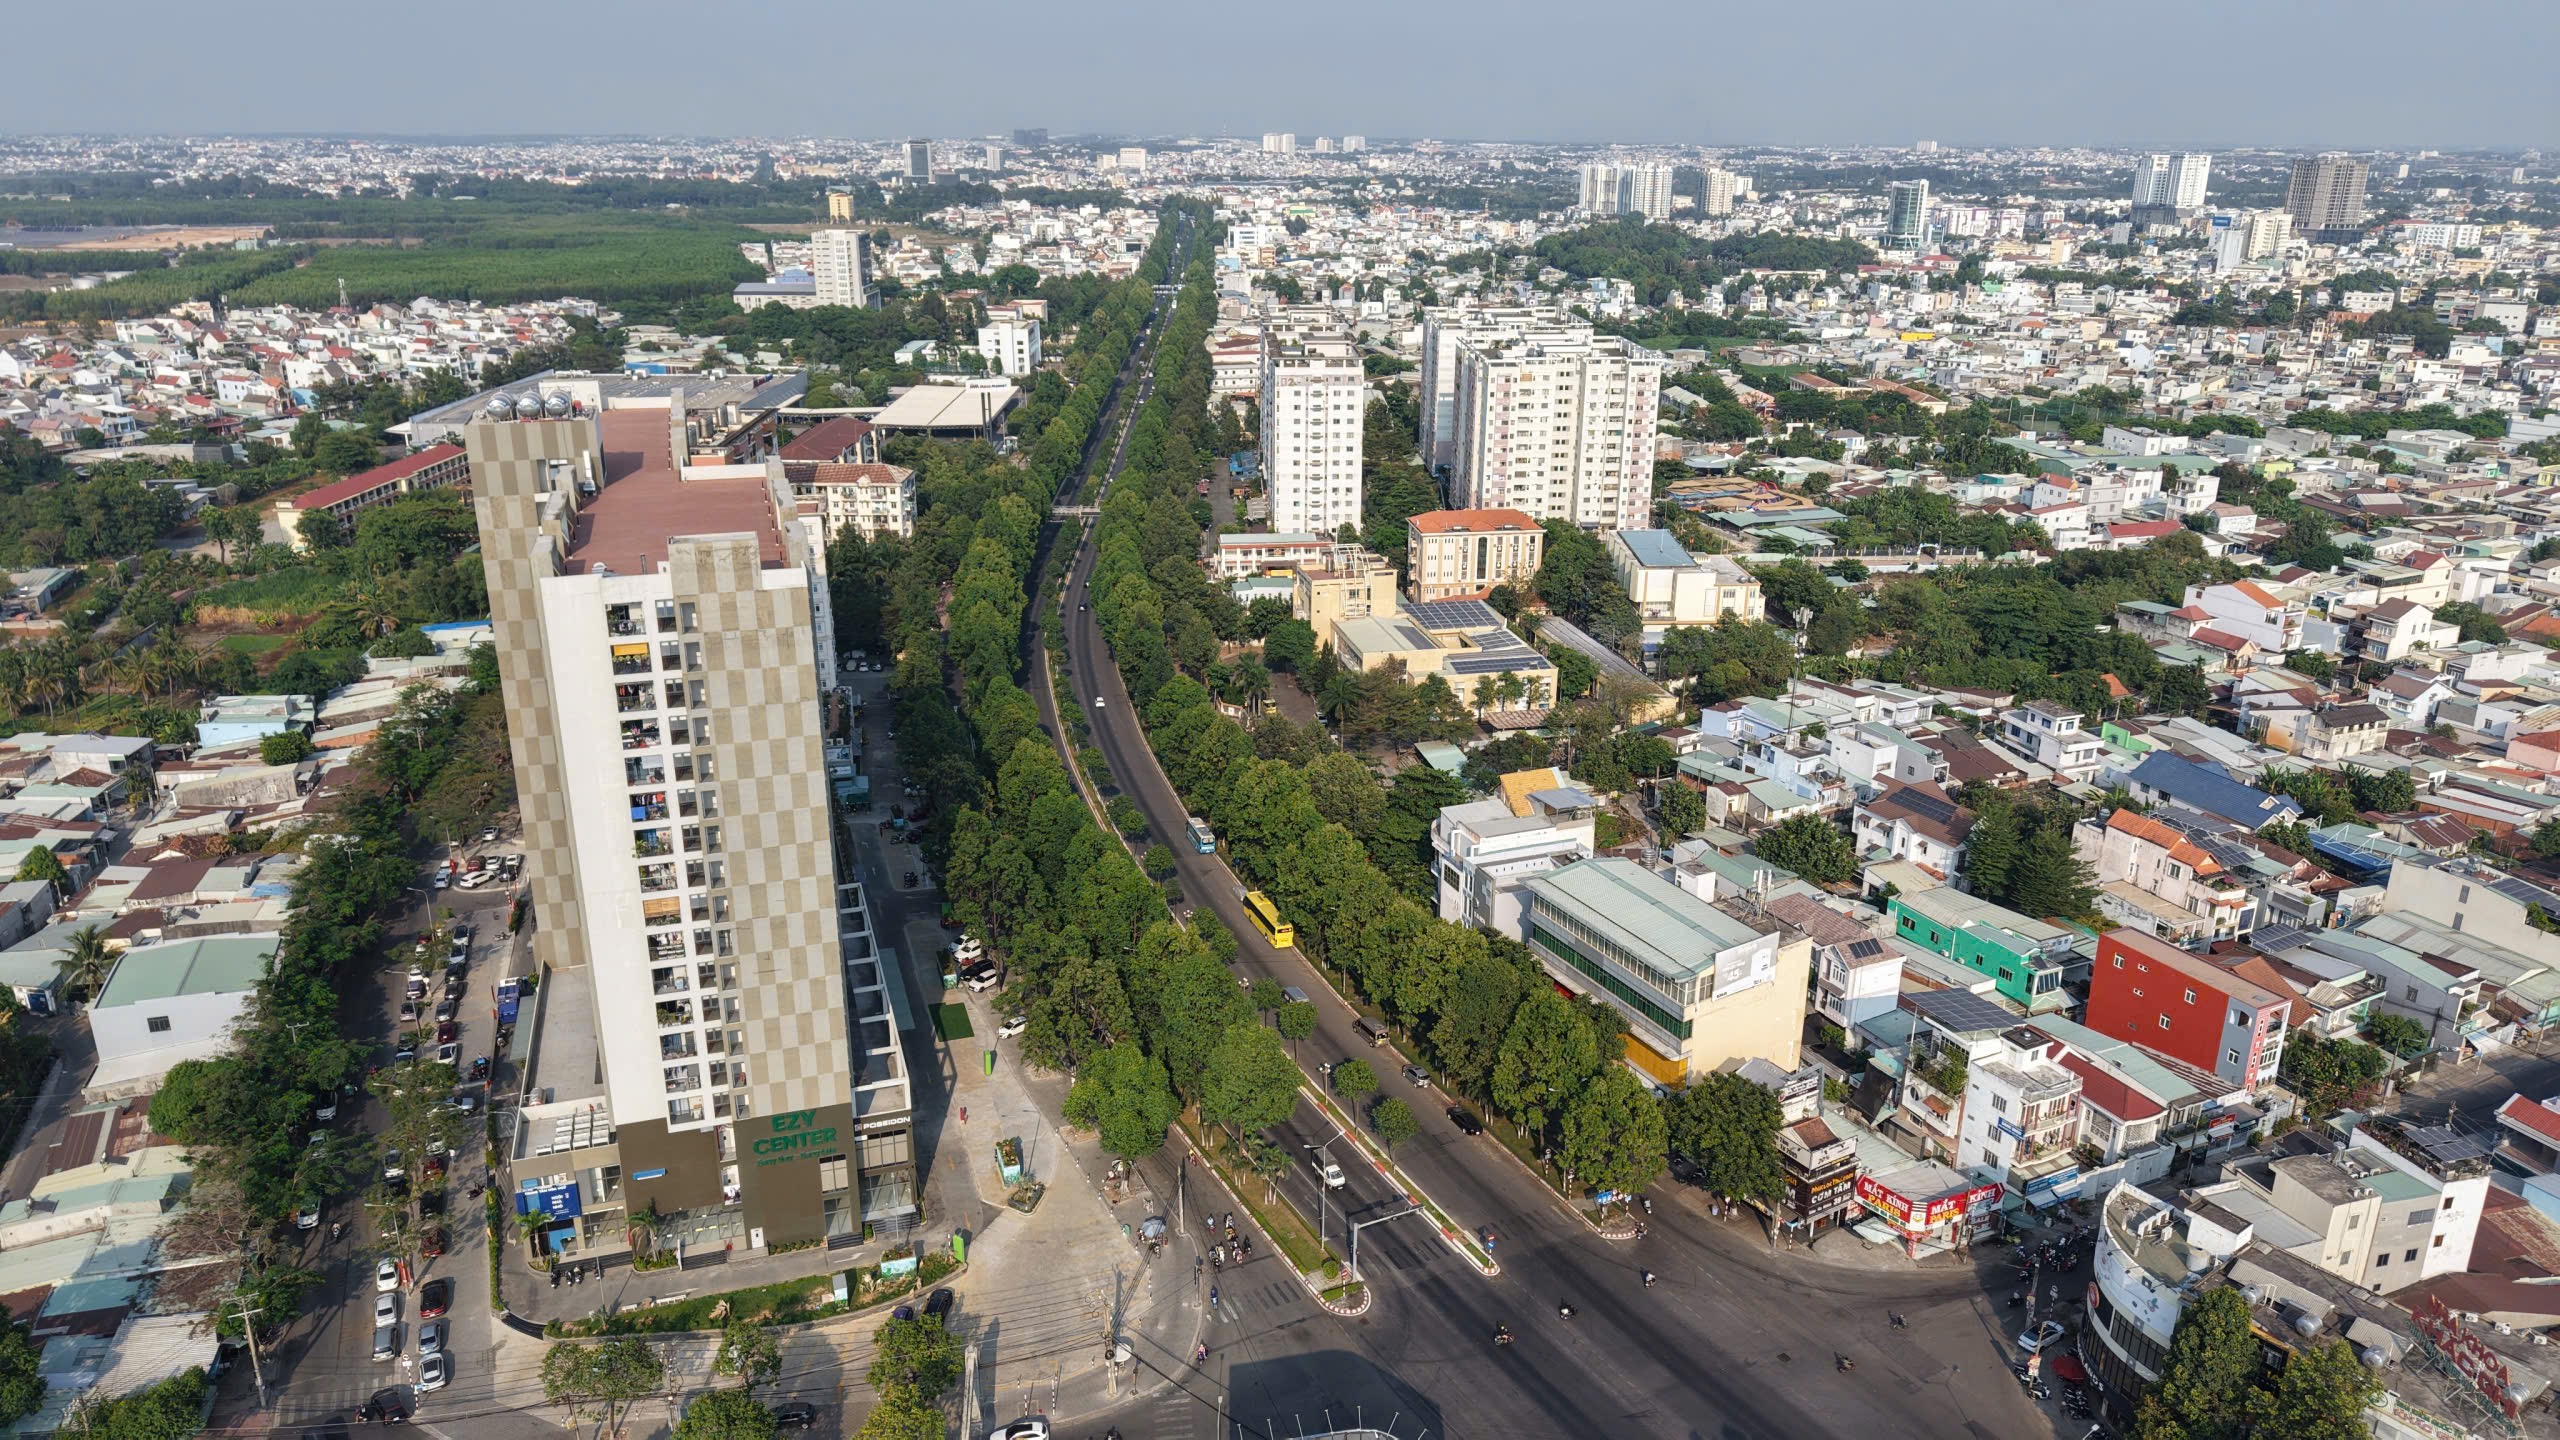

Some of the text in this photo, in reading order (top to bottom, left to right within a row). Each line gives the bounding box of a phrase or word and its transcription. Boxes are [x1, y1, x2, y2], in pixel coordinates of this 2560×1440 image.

[771, 1109, 816, 1132] EZY
[863, 1115, 911, 1130] POSEIDON
[752, 1127, 836, 1155] CENTER
[1867, 1194, 1902, 1218] PARIS
[1886, 1194, 1910, 1213] KÍNH
[1969, 1189, 1997, 1204] KÍNH
[1929, 1207, 1960, 1224] PARIS
[2455, 1327, 2511, 1388] KHOA
